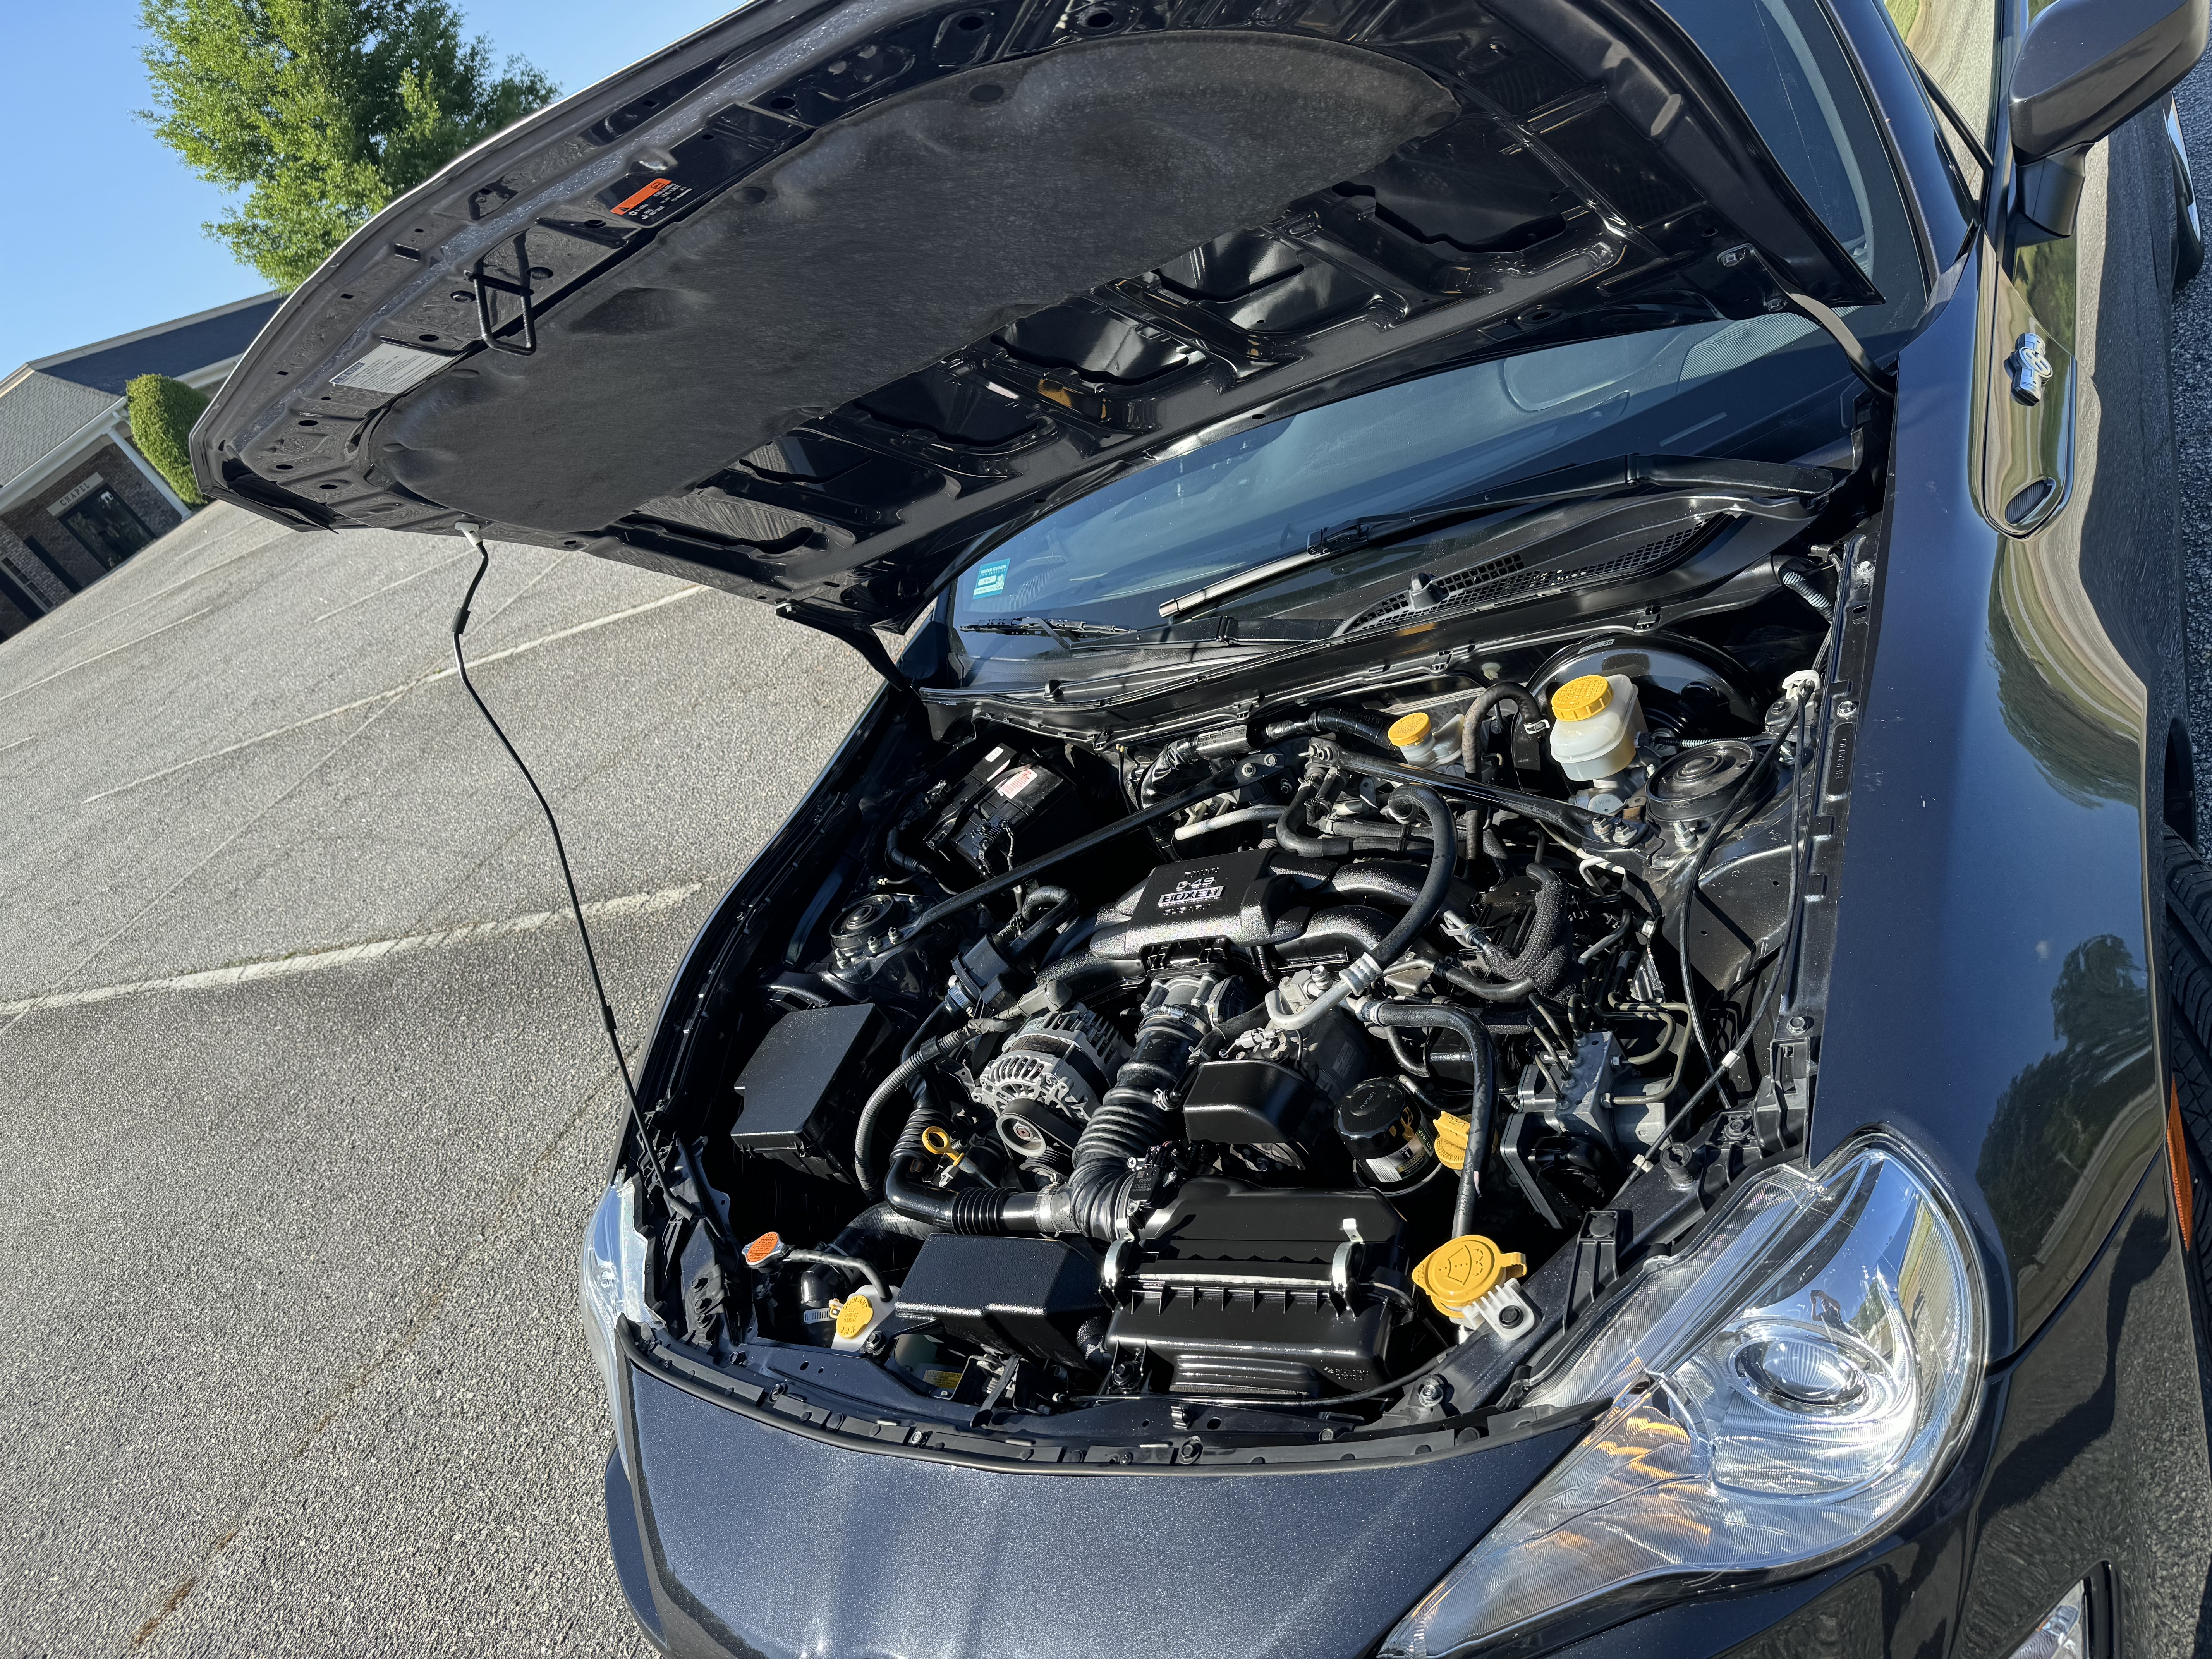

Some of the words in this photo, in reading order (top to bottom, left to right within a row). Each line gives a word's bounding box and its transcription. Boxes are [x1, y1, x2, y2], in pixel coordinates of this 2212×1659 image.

[60, 482, 91, 507] CHAPEL
[1835, 738, 1847, 779] SUBARU
[1184, 867, 1219, 879] TOYOTA
[1176, 876, 1216, 891] D-4S
[1162, 887, 1220, 903] BOXER
[1162, 903, 1211, 916] SUBARU
[843, 1295, 868, 1310] COOLANT
